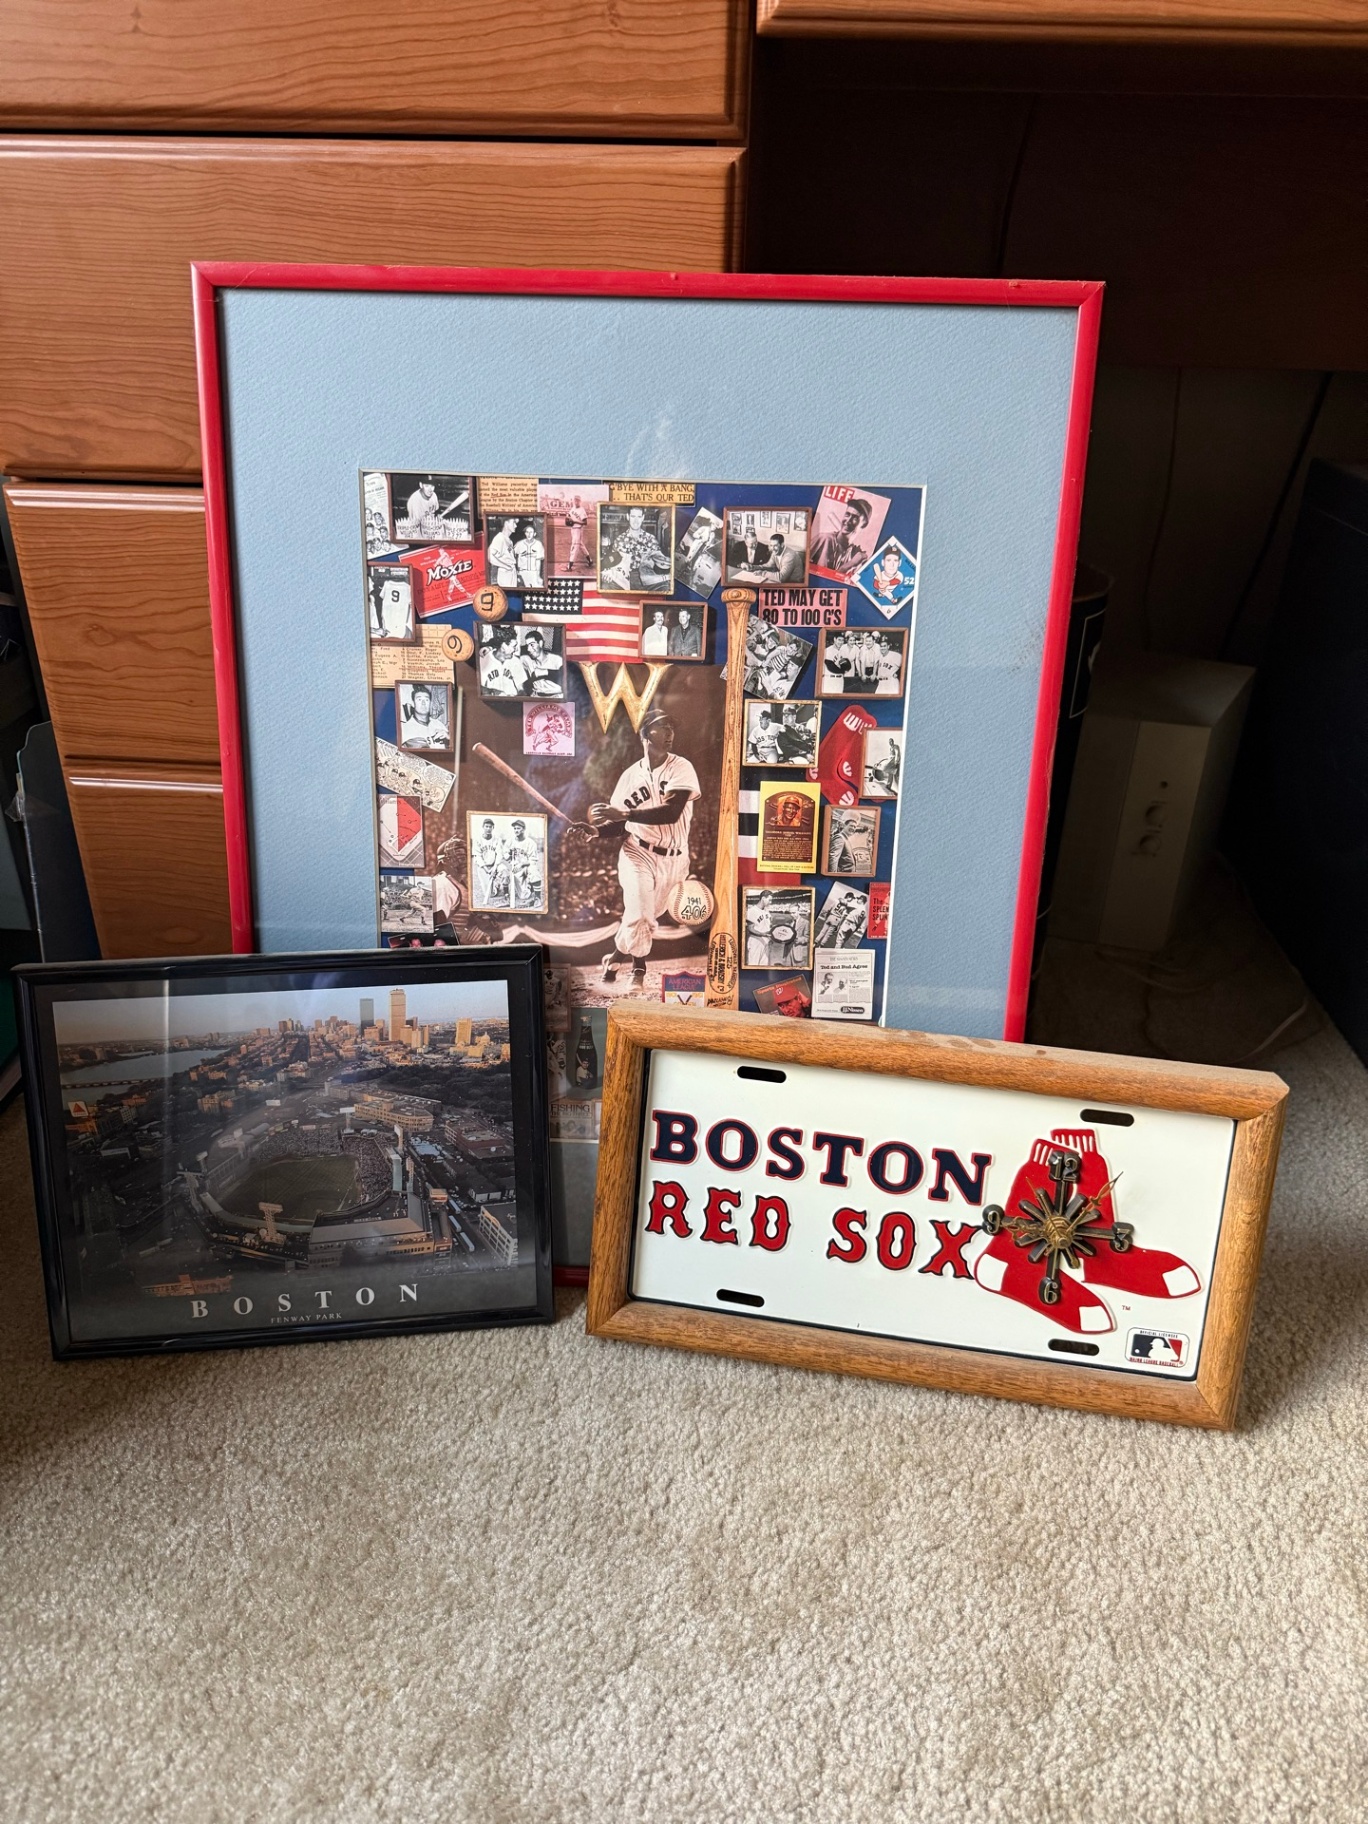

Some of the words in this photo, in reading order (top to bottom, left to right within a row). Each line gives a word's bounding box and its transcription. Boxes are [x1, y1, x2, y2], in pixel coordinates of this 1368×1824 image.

[637, 483, 658, 492] WITH
[660, 484, 668, 492] A
[825, 486, 854, 501] LIFE
[624, 493, 653, 501] THAT'S
[656, 493, 675, 501] OUR
[677, 494, 695, 502] TED
[426, 560, 473, 586] MOXIE
[391, 590, 400, 603] 9
[481, 592, 494, 612] 9
[762, 589, 785, 606] TED
[788, 589, 816, 606] MAY
[819, 590, 843, 607] GET
[762, 609, 779, 625] 80
[783, 609, 798, 625] TO
[801, 609, 820, 625] 100
[824, 609, 842, 625] G'S
[447, 635, 462, 653] 9
[578, 661, 674, 735] W
[623, 786, 651, 810] RED
[687, 897, 702, 905] 1941
[681, 905, 707, 920] .406
[551, 1104, 590, 1112] FISHING
[650, 1109, 992, 1206] BOSTON
[1050, 1151, 1081, 1183] 12
[982, 1204, 1004, 1236] 9
[645, 1180, 791, 1252] RED
[826, 1207, 984, 1280] SOX
[1039, 1277, 1061, 1305] 6
[191, 1283, 418, 1319] BOSTON
[271, 1314, 312, 1324] FENWAY
[316, 1312, 342, 1321] PARK
